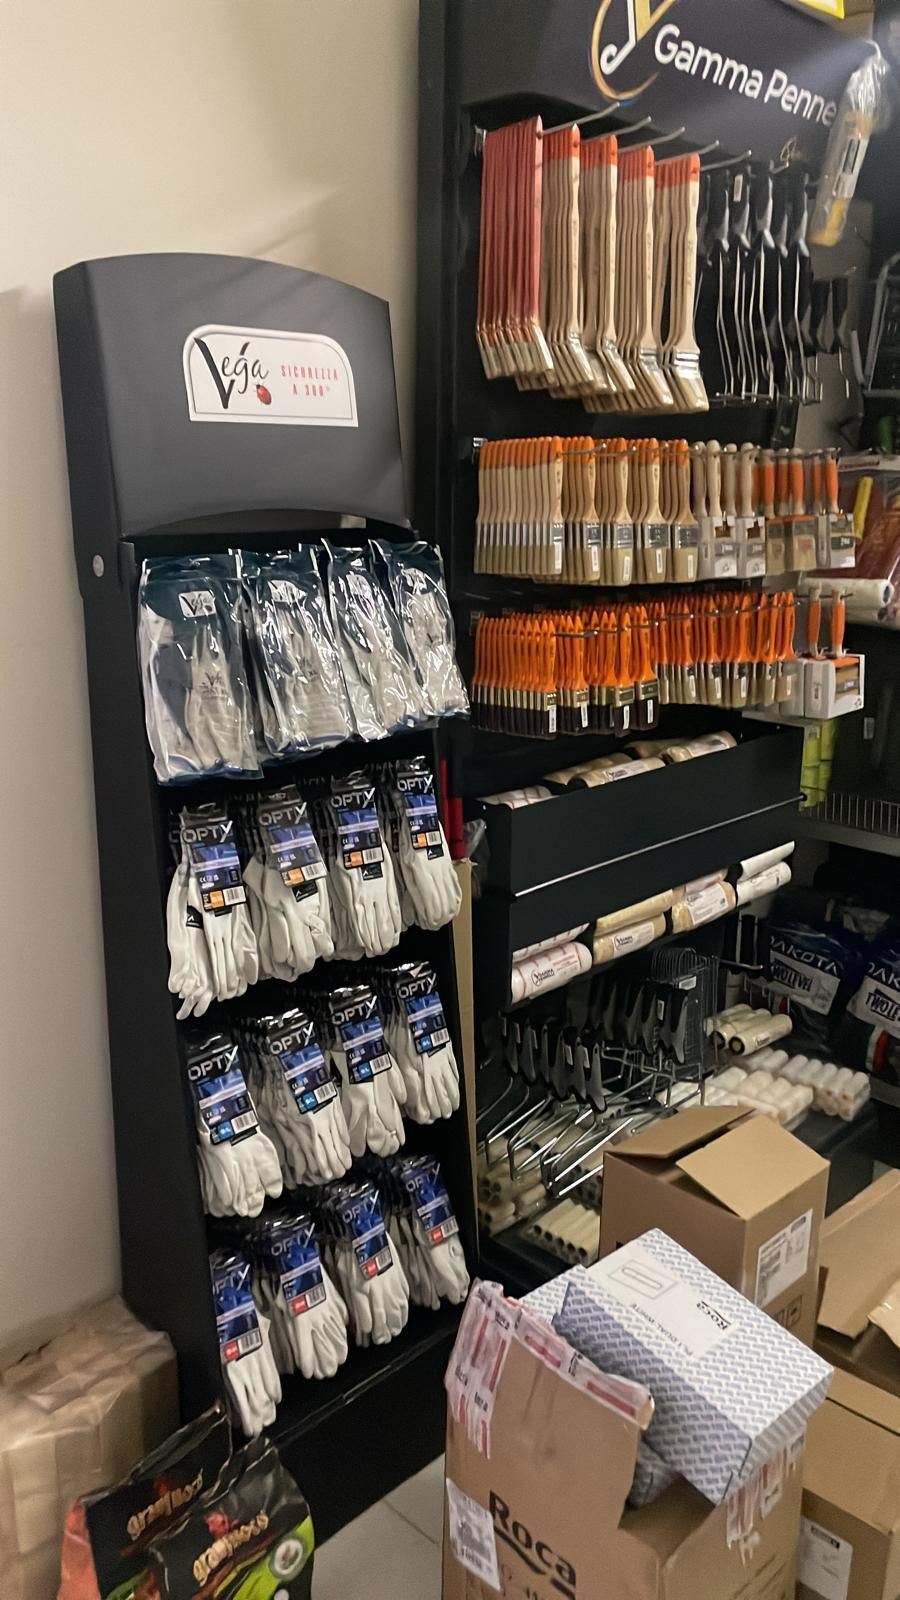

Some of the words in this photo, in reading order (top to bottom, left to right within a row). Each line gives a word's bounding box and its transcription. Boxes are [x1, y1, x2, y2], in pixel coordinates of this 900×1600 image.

[654, 23, 763, 99] Gamma
[764, 69, 838, 126] Penne
[331, 787, 375, 808] OPTY
[397, 774, 433, 793] OPTY
[259, 802, 307, 825] OPTY
[182, 820, 233, 843] OPTY
[399, 973, 436, 999] OPTY
[331, 995, 376, 1025] OPTY
[270, 1021, 313, 1055] OPTY
[188, 1045, 238, 1081] OPTY
[405, 1163, 441, 1192] OPTY
[342, 1190, 380, 1223] OPTY
[271, 1222, 315, 1256] OPTY
[212, 1264, 250, 1295] PTY
[696, 1301, 729, 1330] Roca
[489, 1490, 577, 1589] Roca
